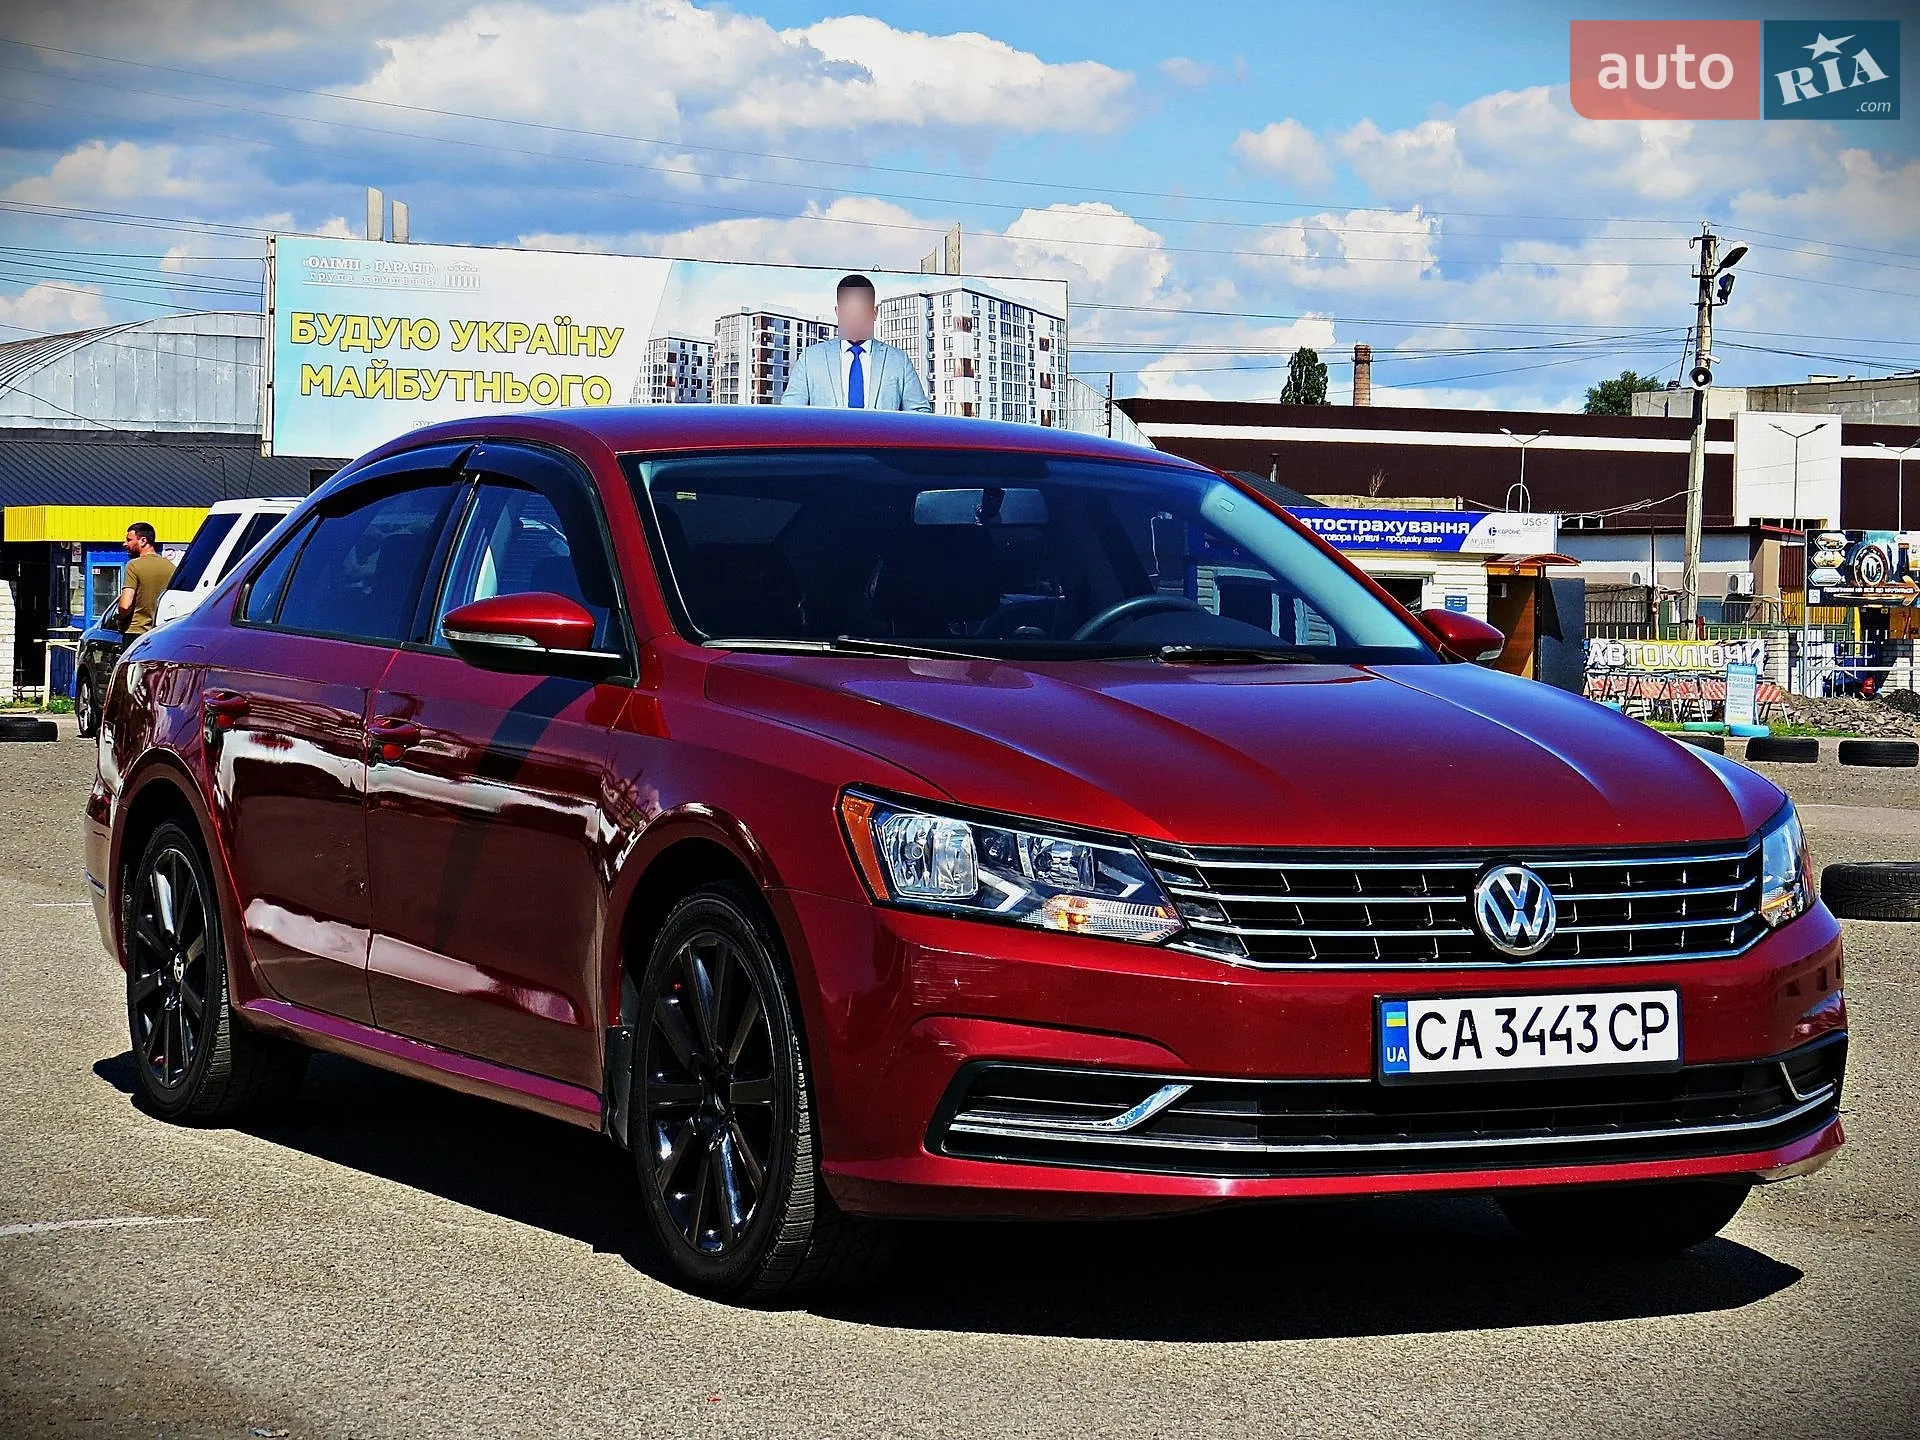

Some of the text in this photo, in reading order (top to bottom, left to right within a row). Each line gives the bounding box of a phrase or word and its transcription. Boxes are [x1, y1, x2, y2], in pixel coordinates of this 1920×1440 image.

[290, 311, 625, 358] БУДУЮ УКРАЇНУ
[300, 359, 612, 407] МАЙБУТНЬОГО
[1296, 517, 1470, 535] втострахування
[1587, 642, 1764, 668] АВТОКЛЮЧИ
[1415, 1001, 1670, 1061] CA 3443 CP
[1386, 1046, 1407, 1063] UA
